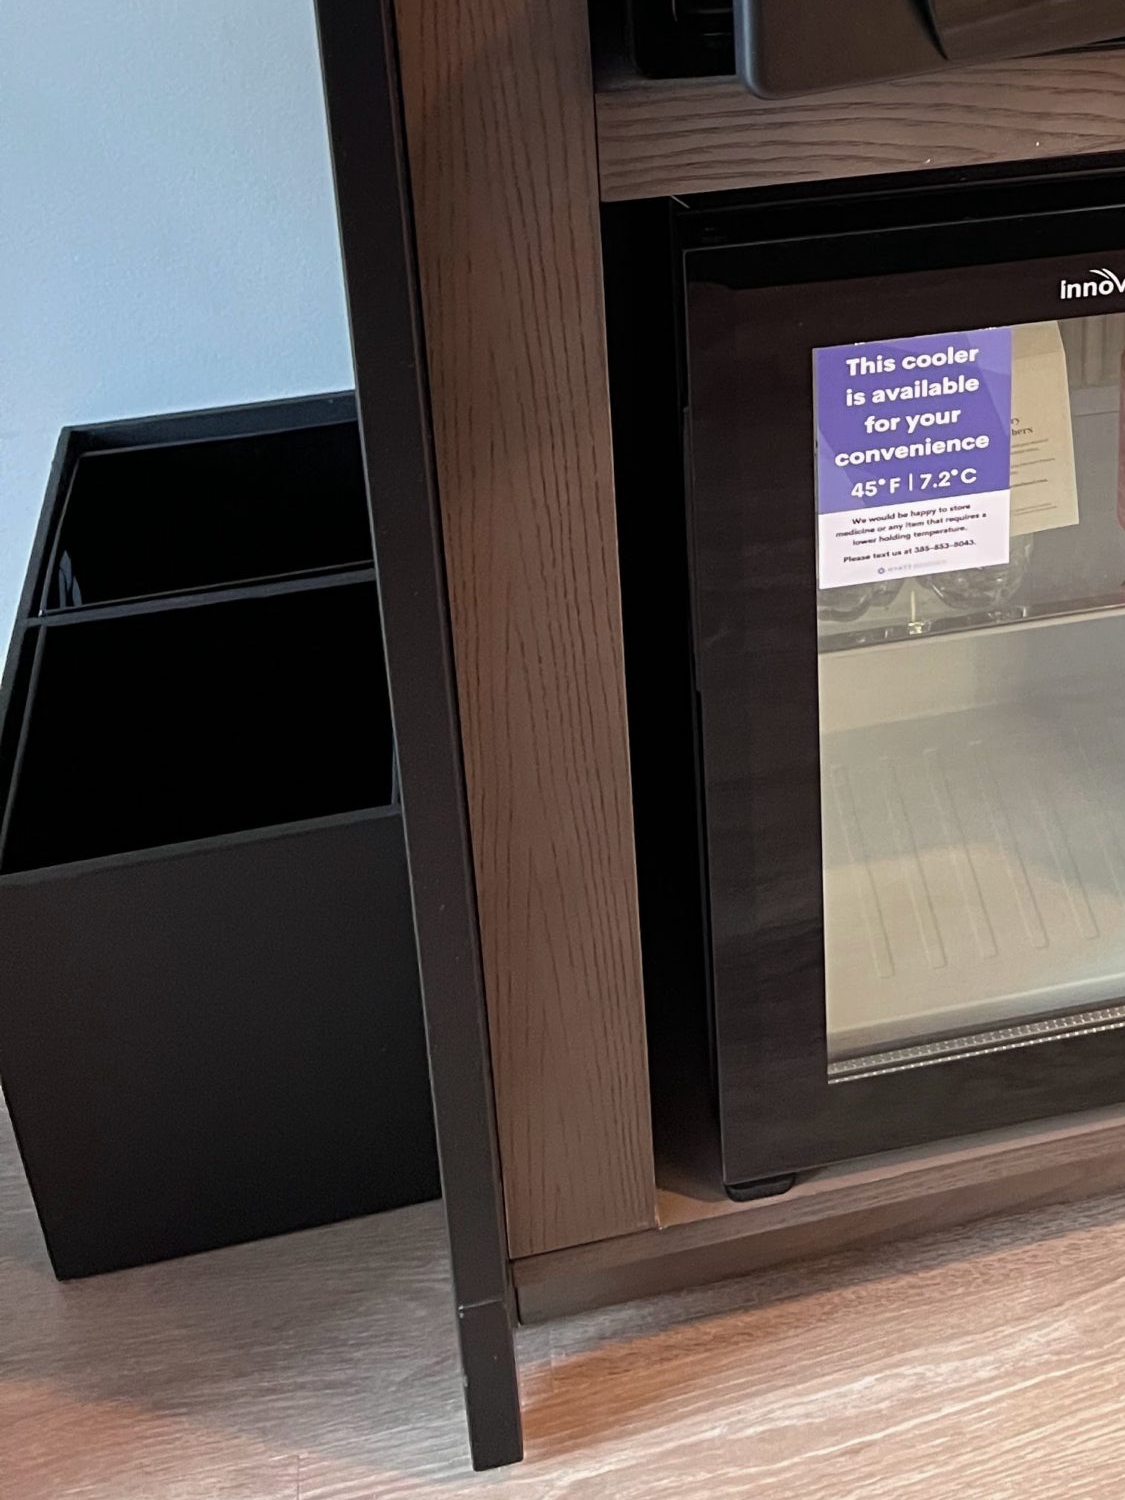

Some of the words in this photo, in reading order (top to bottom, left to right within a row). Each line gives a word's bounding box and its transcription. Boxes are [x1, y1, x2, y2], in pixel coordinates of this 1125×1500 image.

[846, 355, 896, 377] This
[901, 346, 979, 370] cooler
[846, 388, 866, 406] is
[871, 375, 980, 404] available
[864, 415, 900, 434] for
[906, 409, 961, 434] your
[834, 435, 990, 467] convenience
[920, 468, 977, 490] 7.2°C
[835, 527, 875, 538] medicine
[877, 525, 886, 533] or
[888, 523, 903, 532] any
[905, 521, 924, 529] item
[926, 518, 943, 526] that
[945, 513, 979, 524] requires
[869, 513, 895, 523] would
[897, 511, 909, 519] be
[910, 508, 936, 519] happy
[938, 506, 948, 514] to
[949, 504, 971, 512] store
[852, 538, 877, 546] lower
[878, 532, 911, 543] holding
[913, 525, 968, 538] temperature.
[843, 555, 871, 563] Please
[873, 551, 890, 559] text
[903, 547, 912, 555] at
